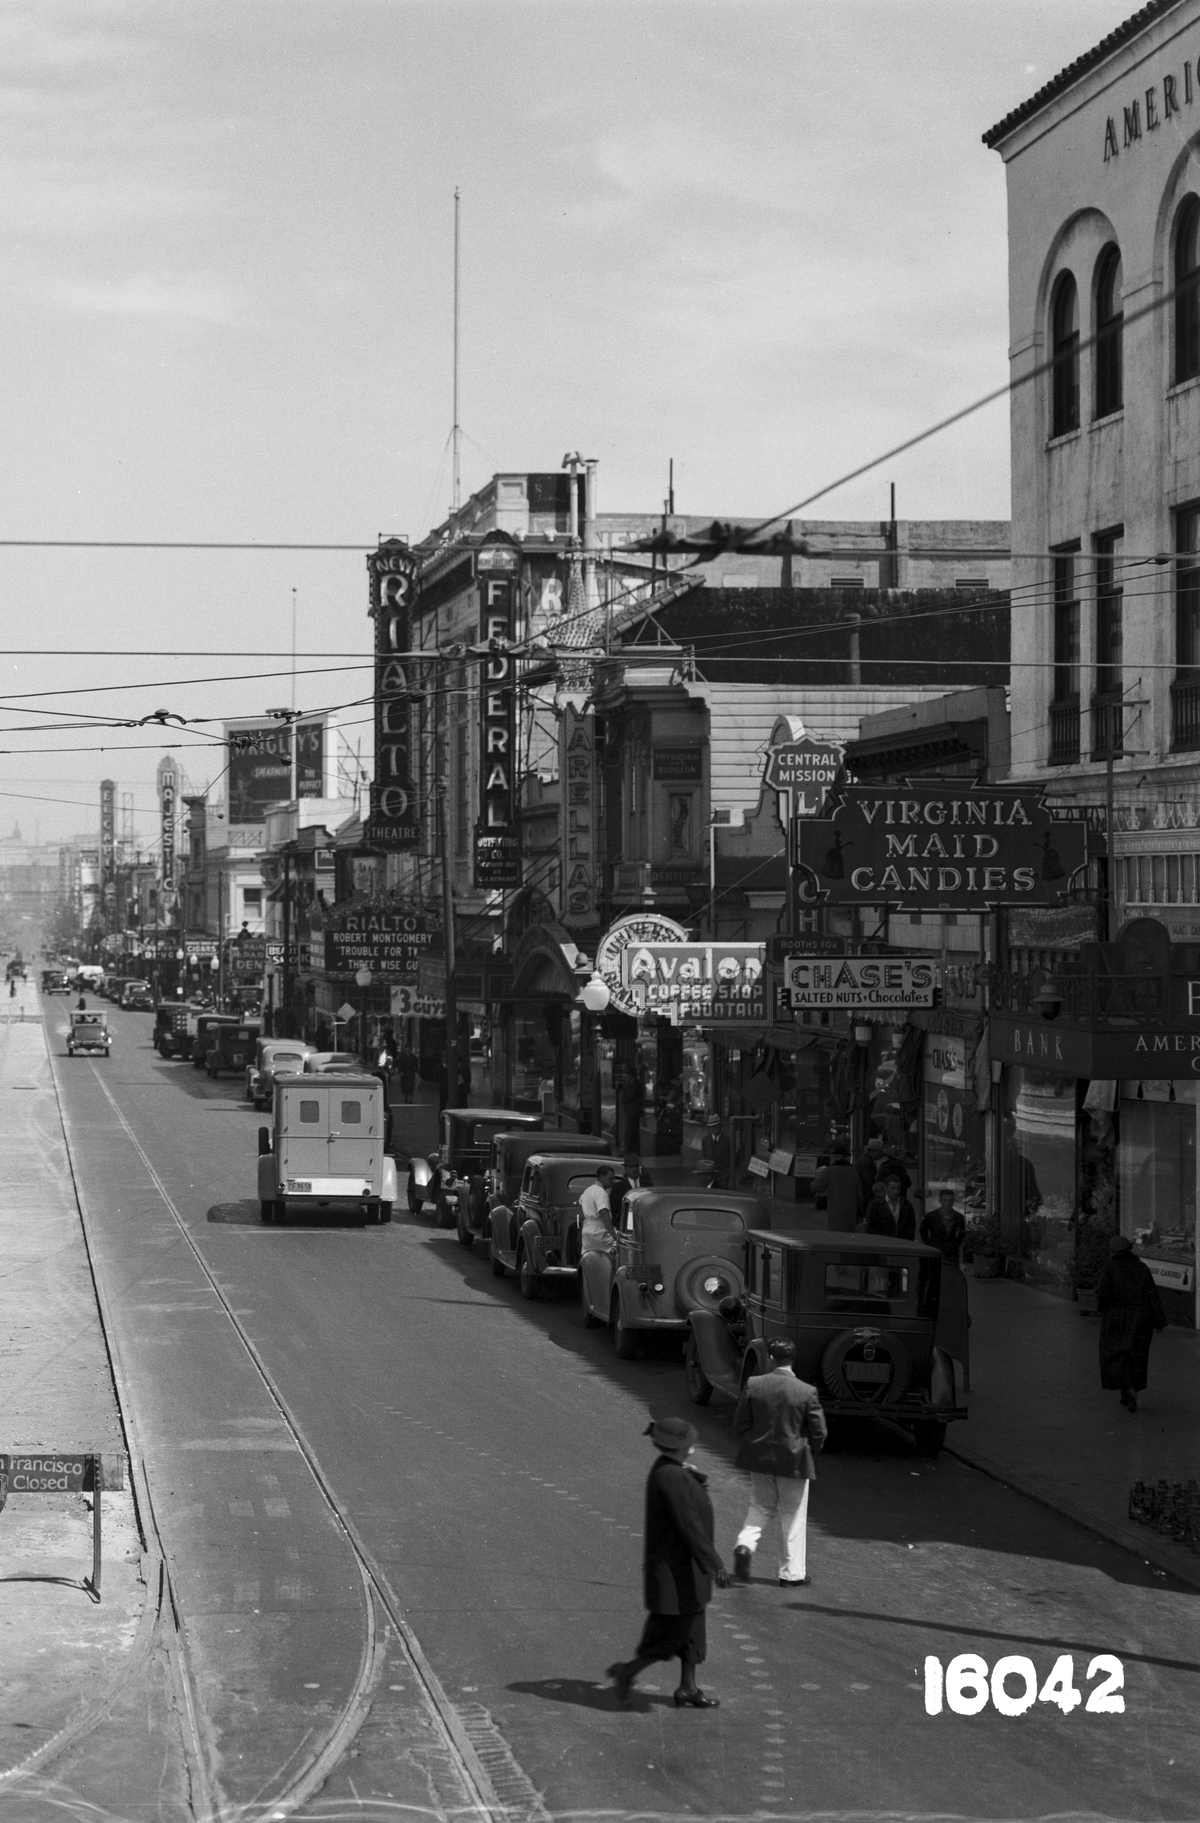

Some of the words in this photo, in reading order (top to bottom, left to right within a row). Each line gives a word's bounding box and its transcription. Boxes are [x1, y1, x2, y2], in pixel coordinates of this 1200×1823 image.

[376, 557, 413, 575] NEW
[380, 574, 409, 818] RIALTO
[487, 580, 509, 827] FEDERAL
[777, 754, 837, 767] CENTRAL
[778, 770, 836, 782] MISSION
[856, 799, 1033, 826] VIRGINIA
[371, 827, 417, 839] THEATRE
[885, 833, 1000, 858] MAID
[797, 791, 819, 932] LCH
[850, 864, 1037, 892] CANDIES
[346, 915, 417, 932] RIALTO
[333, 933, 368, 943] ROBERT
[372, 933, 433, 944] MONTGOMERY
[781, 941, 818, 949] BOOTHS
[821, 941, 838, 949] FOR
[341, 946, 379, 957] TROUBLE
[384, 947, 402, 957] FOR
[380, 960, 401, 970] WISE
[791, 961, 932, 989] CHASE'S
[648, 984, 713, 1000] COFFEE
[718, 985, 763, 1000] SHOP
[795, 992, 834, 1004] SALTED
[836, 992, 862, 1004] NUTS
[868, 989, 929, 1004] Chocolates
[680, 1002, 764, 1018] FOUNTAIN
[1014, 1029, 1064, 1061] BANK
[10, 1456, 82, 1475] Francisco
[13, 1475, 68, 1490] Closed
